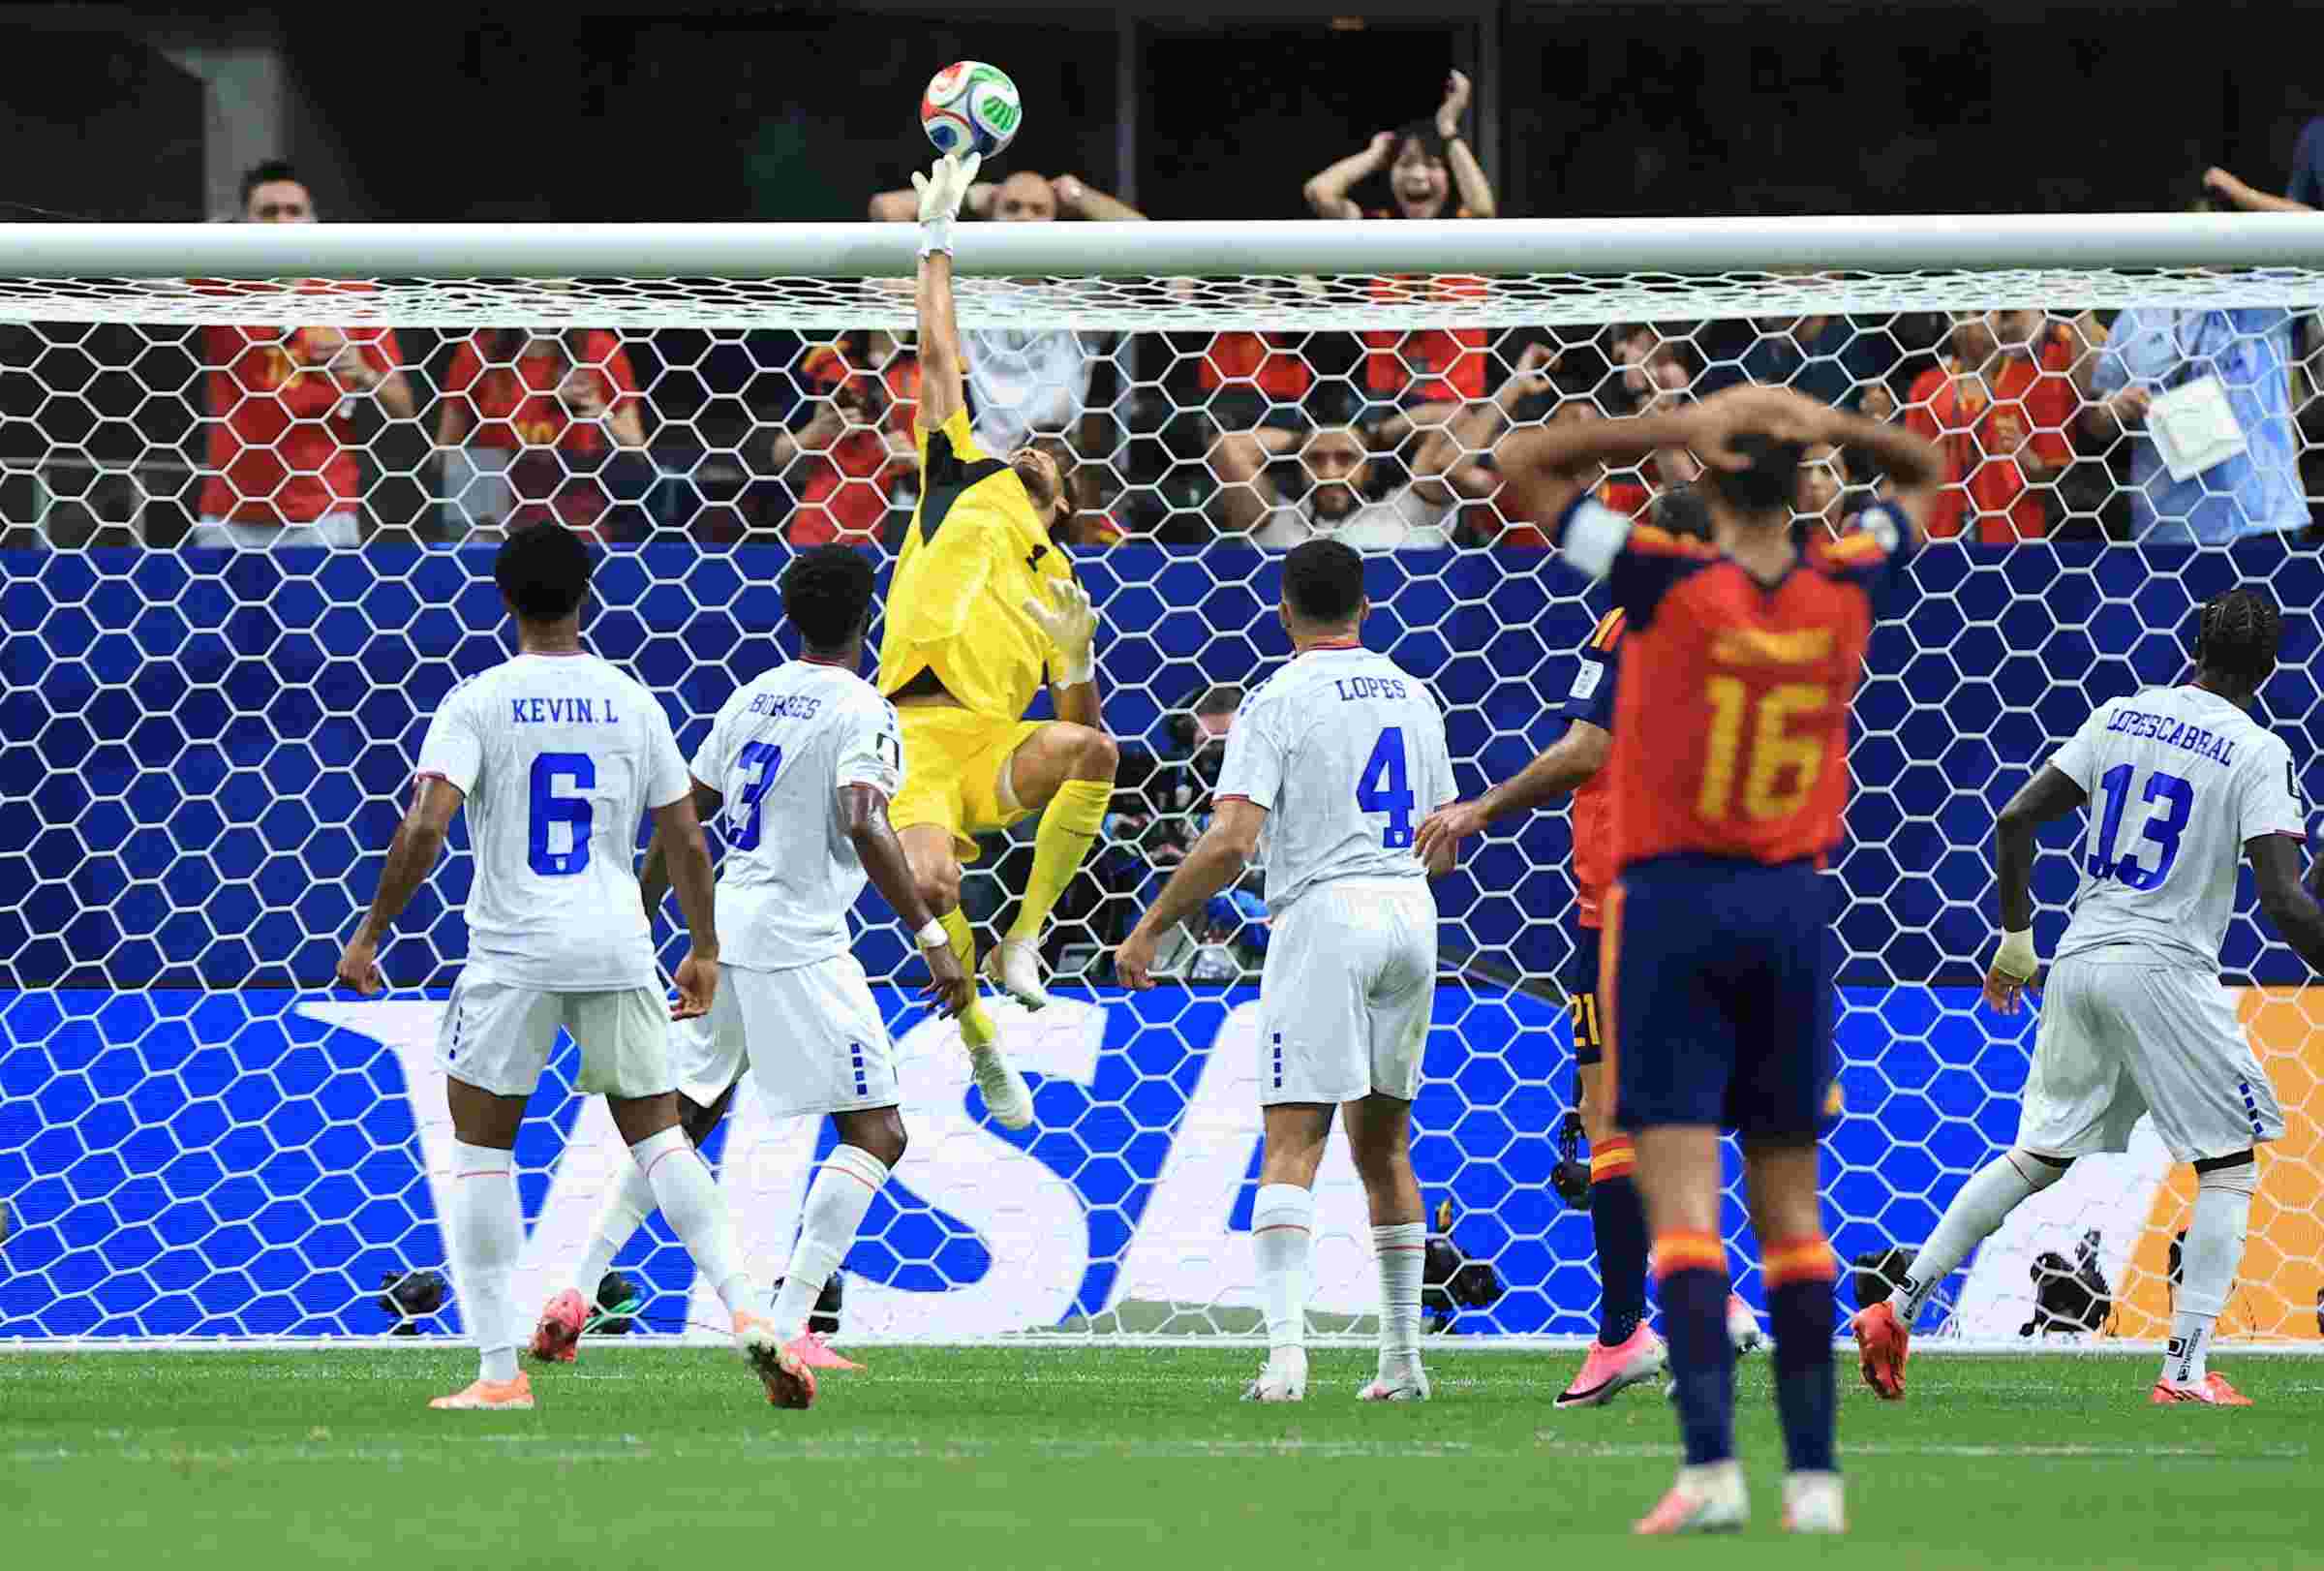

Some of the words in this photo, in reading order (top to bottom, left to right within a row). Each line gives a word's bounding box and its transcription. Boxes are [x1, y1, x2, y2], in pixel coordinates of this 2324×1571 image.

[1334, 675, 1407, 701] LOPES
[2105, 708, 2236, 767] LOPESCABRAL
[726, 740, 782, 852] 3
[1356, 726, 1415, 848] 4
[1697, 675, 1828, 819] 16
[527, 752, 596, 876] 6
[2087, 763, 2194, 891] 13
[1571, 993, 1601, 1047] 21
